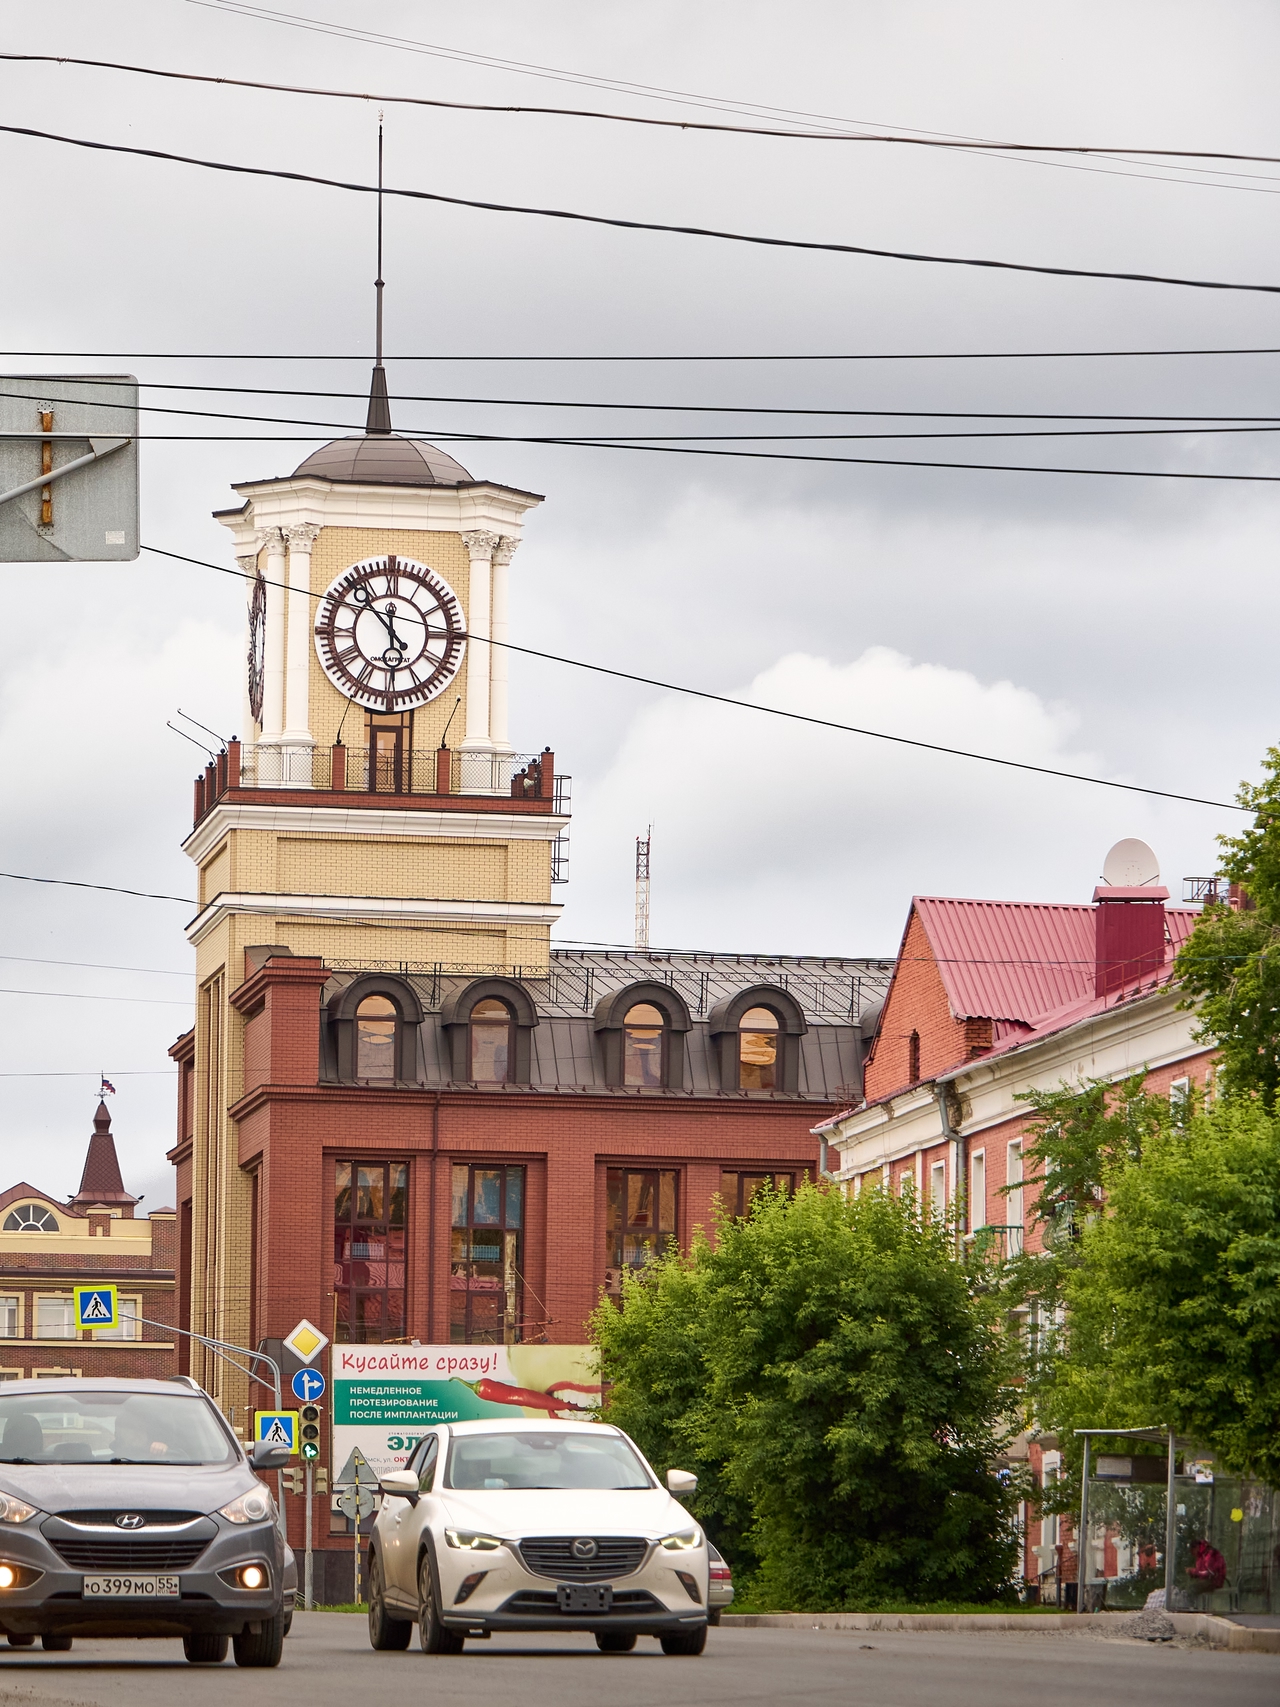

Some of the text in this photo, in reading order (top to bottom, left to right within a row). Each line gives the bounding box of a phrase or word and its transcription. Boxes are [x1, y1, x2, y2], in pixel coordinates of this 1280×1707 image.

[341, 1352, 498, 1374] Кусайте сразу!
[349, 1386, 422, 1396] НЕМЕДЛЕННОЕ
[349, 1398, 439, 1407] ПРОТЕЗИРОВАНИЕ
[349, 1410, 459, 1420] ПОСЛЕ ИМПЛАНТАЦИИ
[158, 1578, 173, 1589] 55
